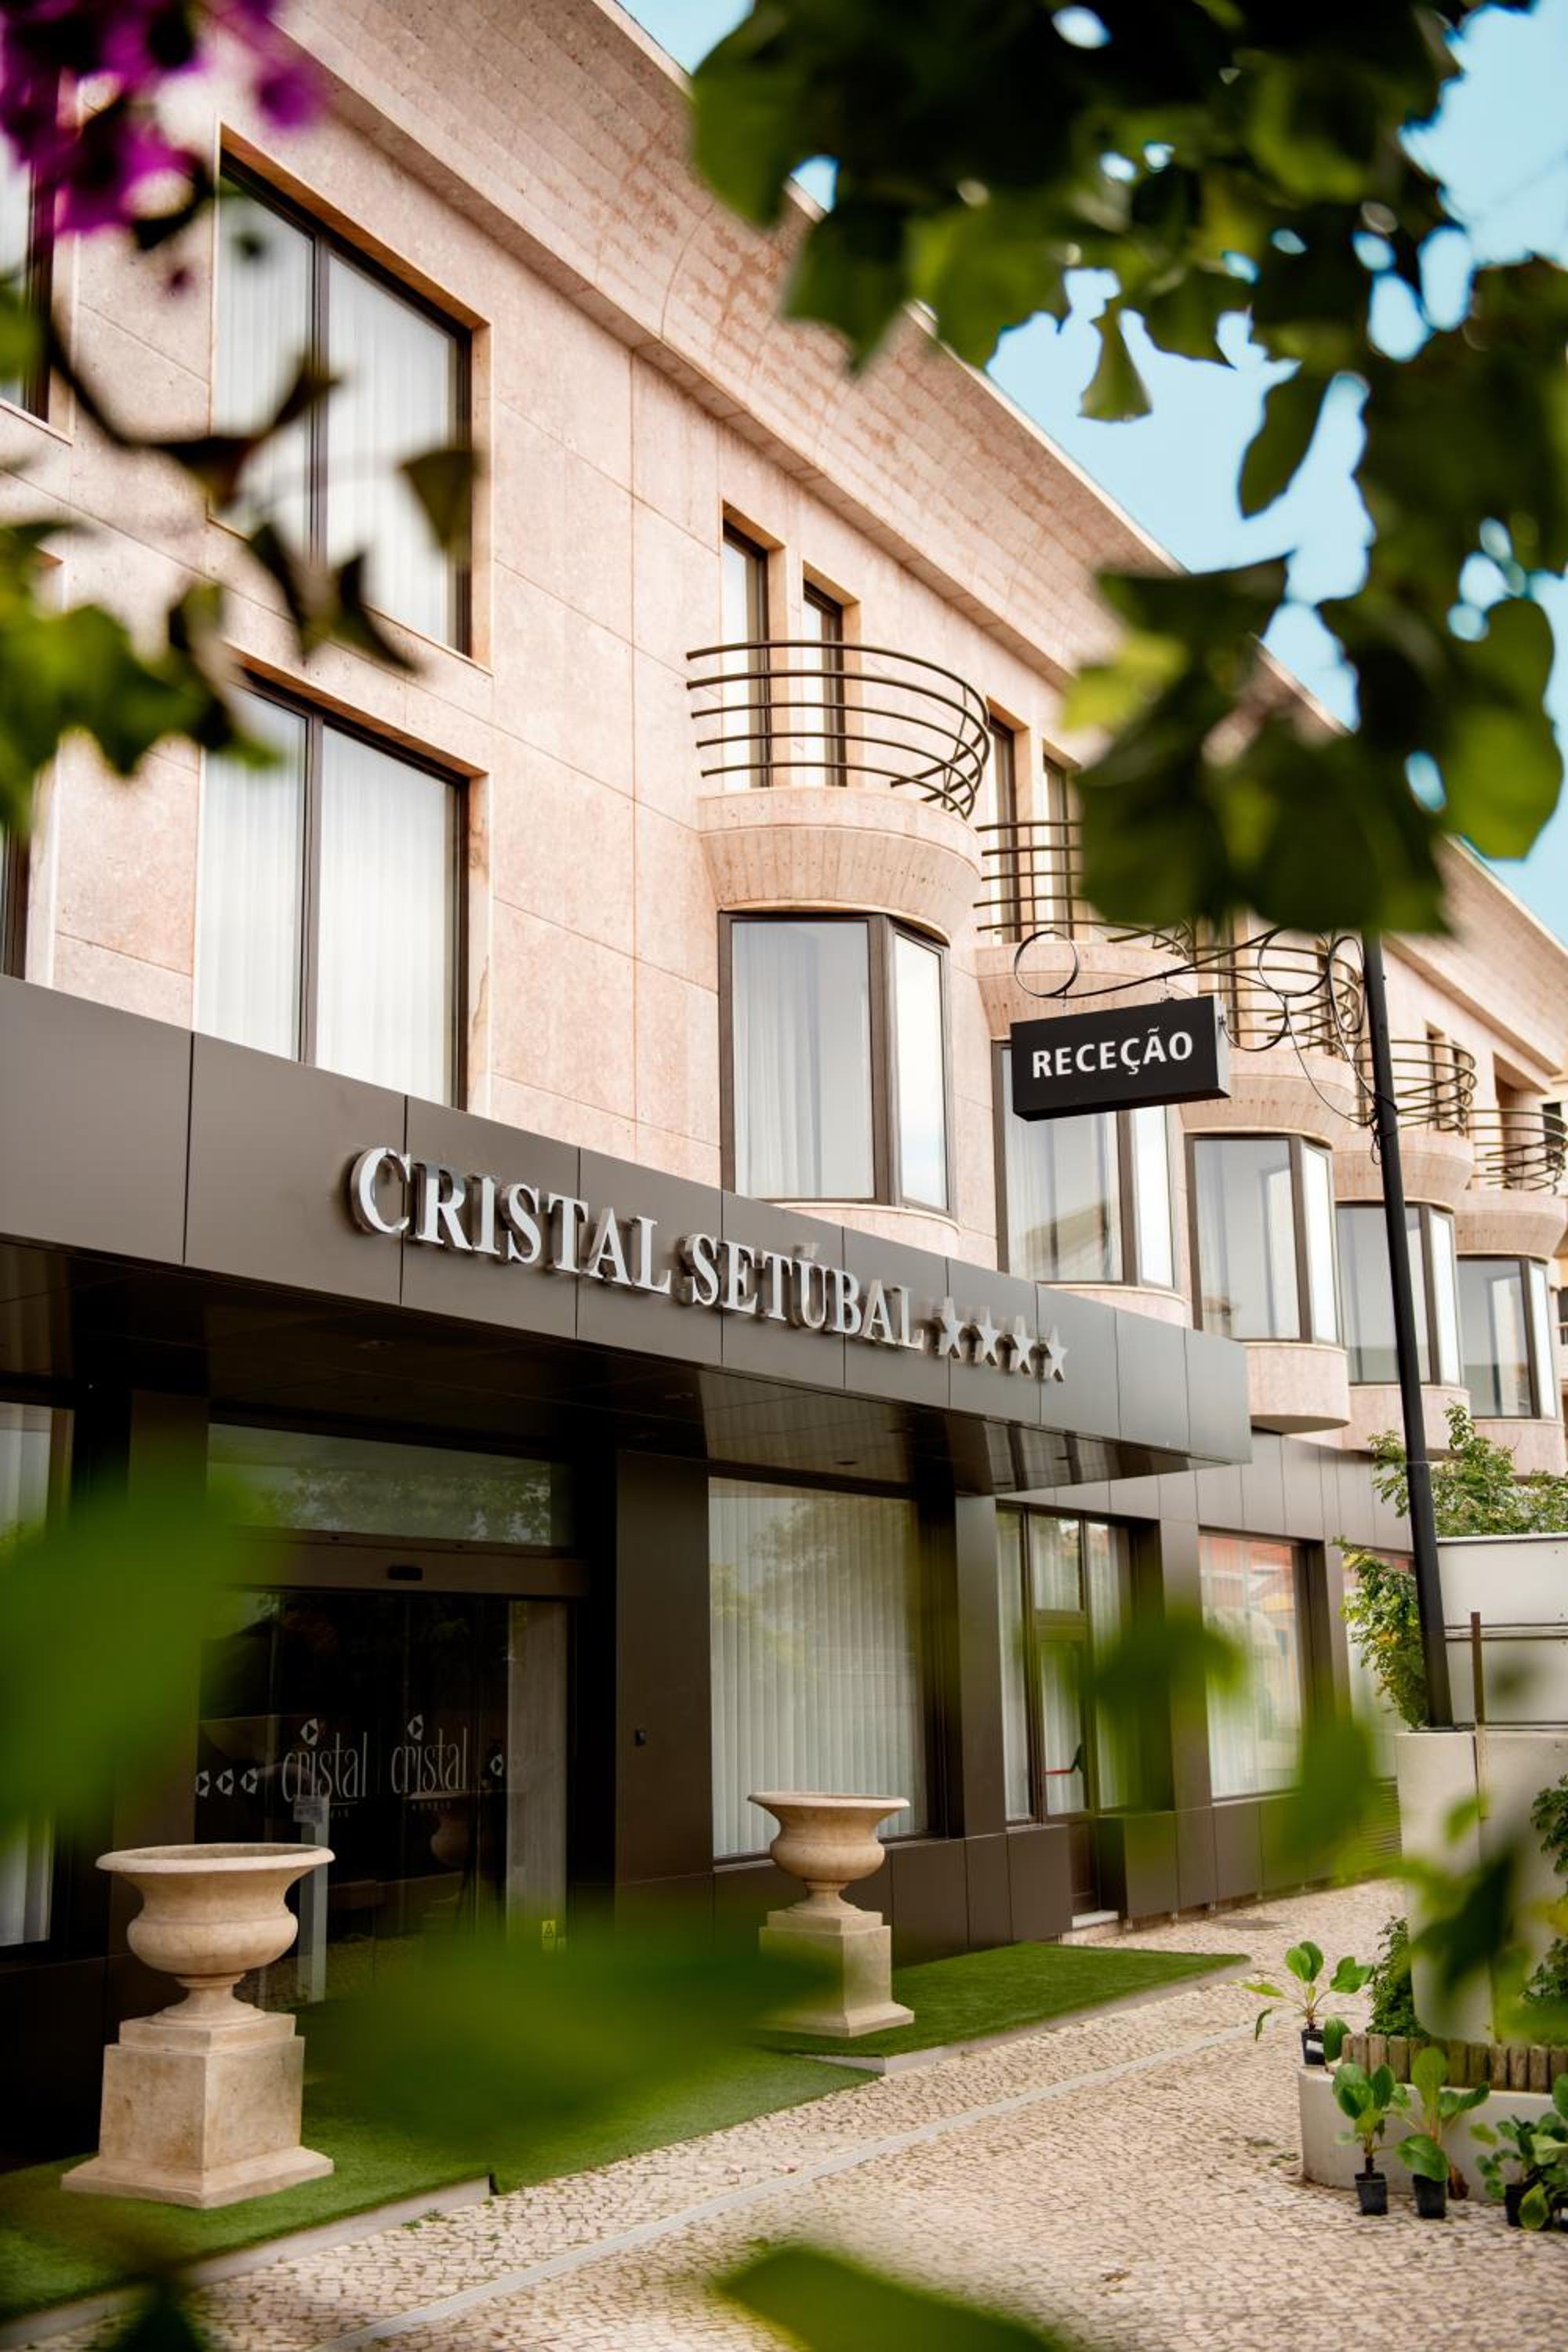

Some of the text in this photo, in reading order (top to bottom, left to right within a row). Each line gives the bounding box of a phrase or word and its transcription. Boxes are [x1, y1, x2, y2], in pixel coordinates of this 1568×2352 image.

[1033, 1026, 1193, 1079] RECEÇÃO
[350, 1147, 672, 1295] CRISTAL
[281, 1731, 368, 1803] cristal
[391, 1726, 468, 1795] cristal
